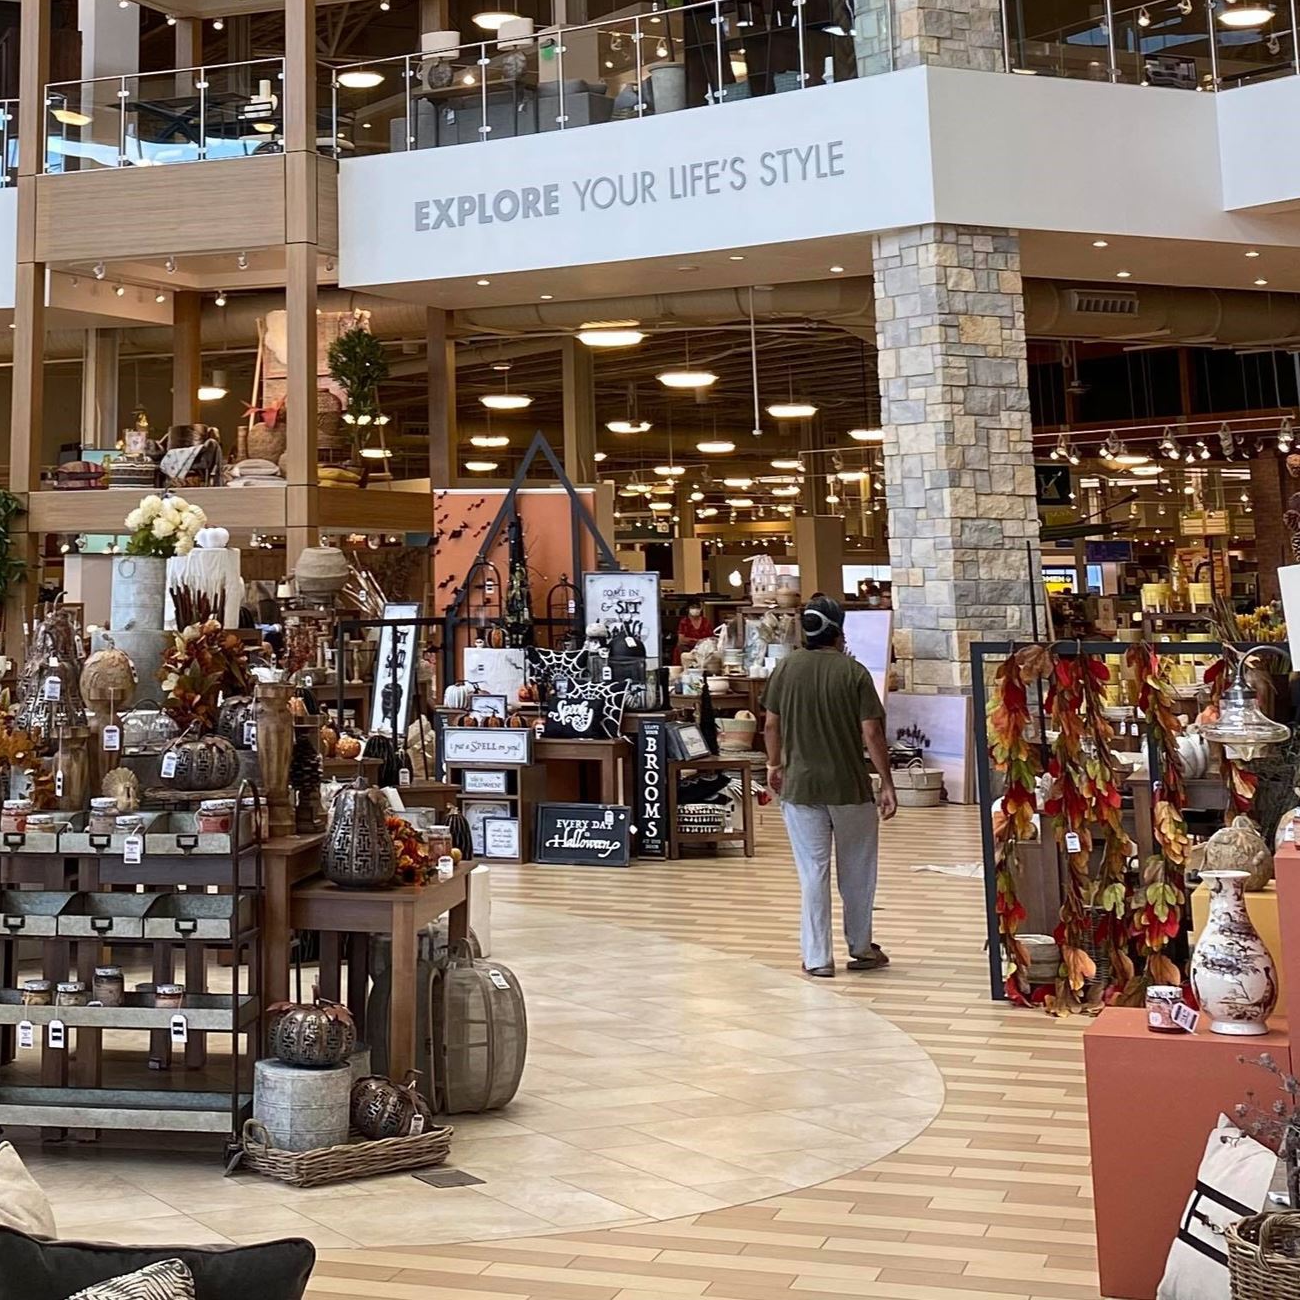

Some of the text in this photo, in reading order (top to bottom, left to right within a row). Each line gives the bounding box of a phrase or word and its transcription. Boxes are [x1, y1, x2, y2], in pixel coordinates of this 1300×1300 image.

[413, 140, 845, 232] EXPLORE YOUR LIFE'S STYLE
[615, 600, 642, 614] SIT
[642, 736, 661, 838] BROOMS
[556, 819, 589, 829] EVERY
